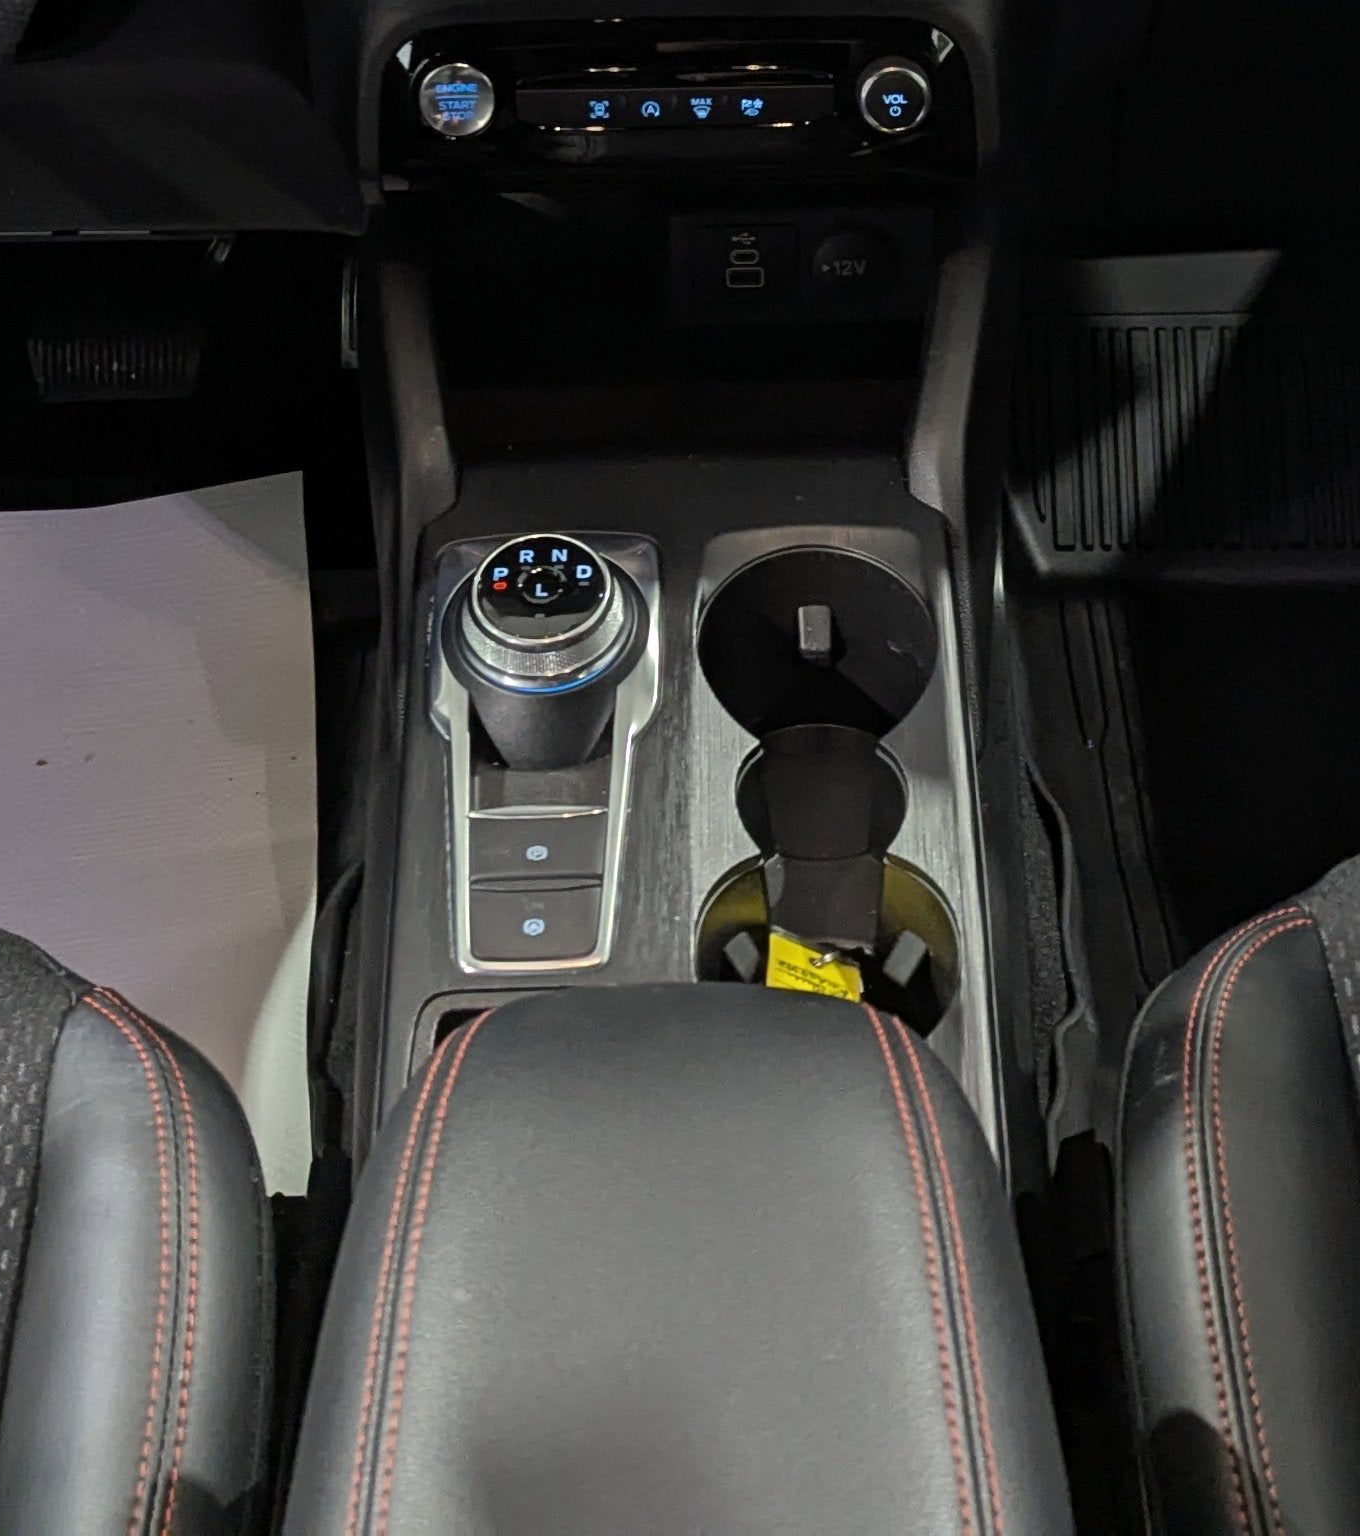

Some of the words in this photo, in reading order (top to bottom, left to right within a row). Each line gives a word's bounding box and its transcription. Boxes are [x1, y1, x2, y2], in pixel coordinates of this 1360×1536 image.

[435, 83, 478, 94] ENGINE
[438, 100, 477, 111] START
[690, 97, 713, 106] MAX
[882, 94, 908, 105] VOL
[442, 111, 474, 121] STOP
[833, 259, 867, 276] 12V
[519, 549, 535, 563] R
[551, 548, 568, 563] N
[492, 567, 509, 581] P
[575, 564, 593, 579] D
[535, 583, 549, 597] L
